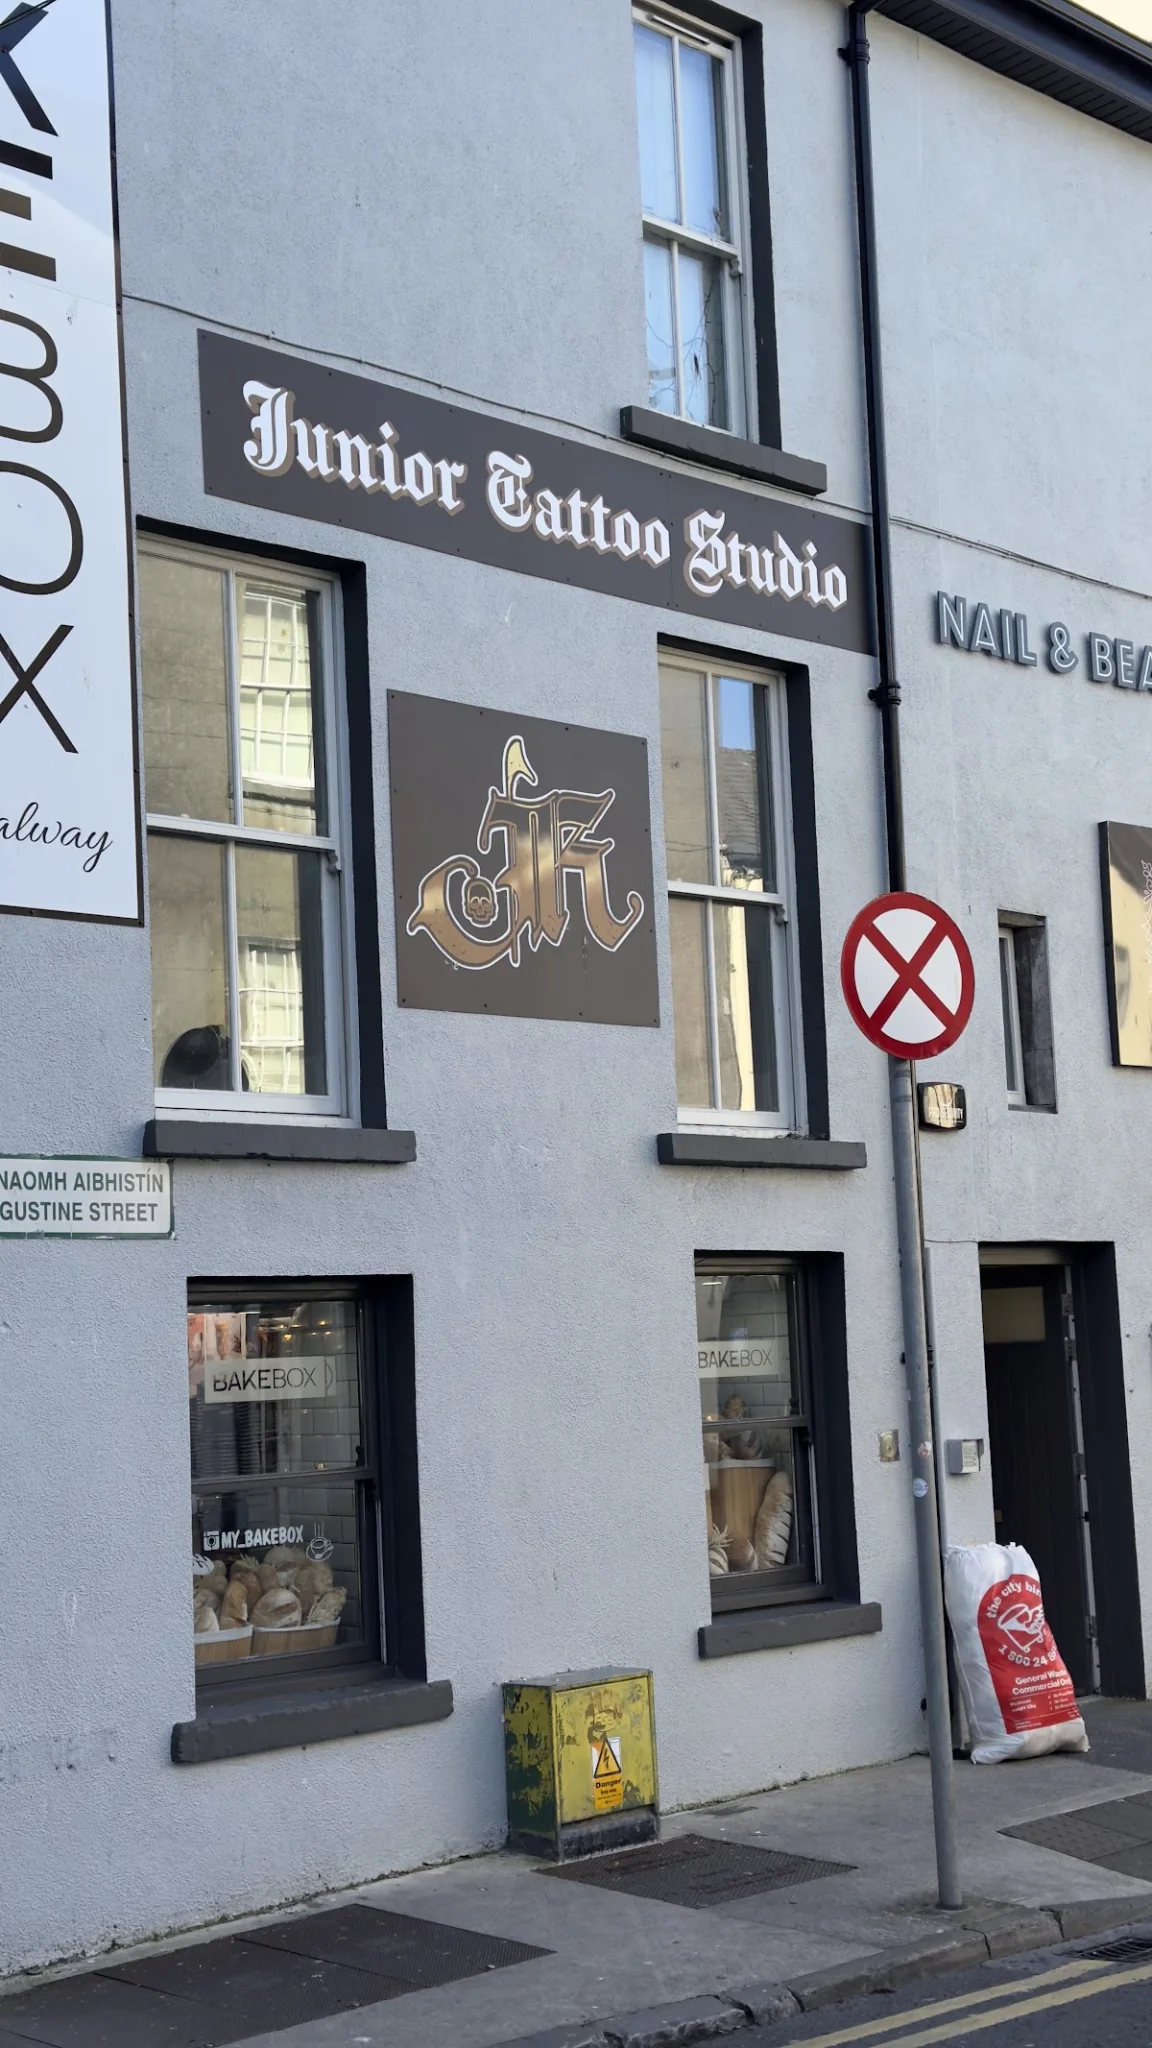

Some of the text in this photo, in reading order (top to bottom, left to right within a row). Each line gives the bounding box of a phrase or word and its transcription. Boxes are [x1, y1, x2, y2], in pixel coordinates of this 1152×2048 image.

[243, 380, 848, 610] Junior Tattoo Studio
[937, 590, 1037, 667] NAIL
[1050, 621, 1079, 675] &
[73, 1167, 164, 1193] AIBHISTÍN
[0, 1201, 158, 1222] GUSTINE STREET
[698, 1348, 772, 1369] BAKEBOX
[213, 1366, 317, 1392] BAKEBOX
[221, 1525, 304, 1549] MY_BAKEBOX
[986, 1596, 1002, 1618] the
[1001, 1581, 1022, 1597] city
[998, 1644, 1008, 1655] 1
[1033, 1655, 1048, 1667] 24
[1012, 1679, 1060, 1695] Commercial
[1015, 1673, 1048, 1685] General
[595, 1779, 622, 1789] Danger
